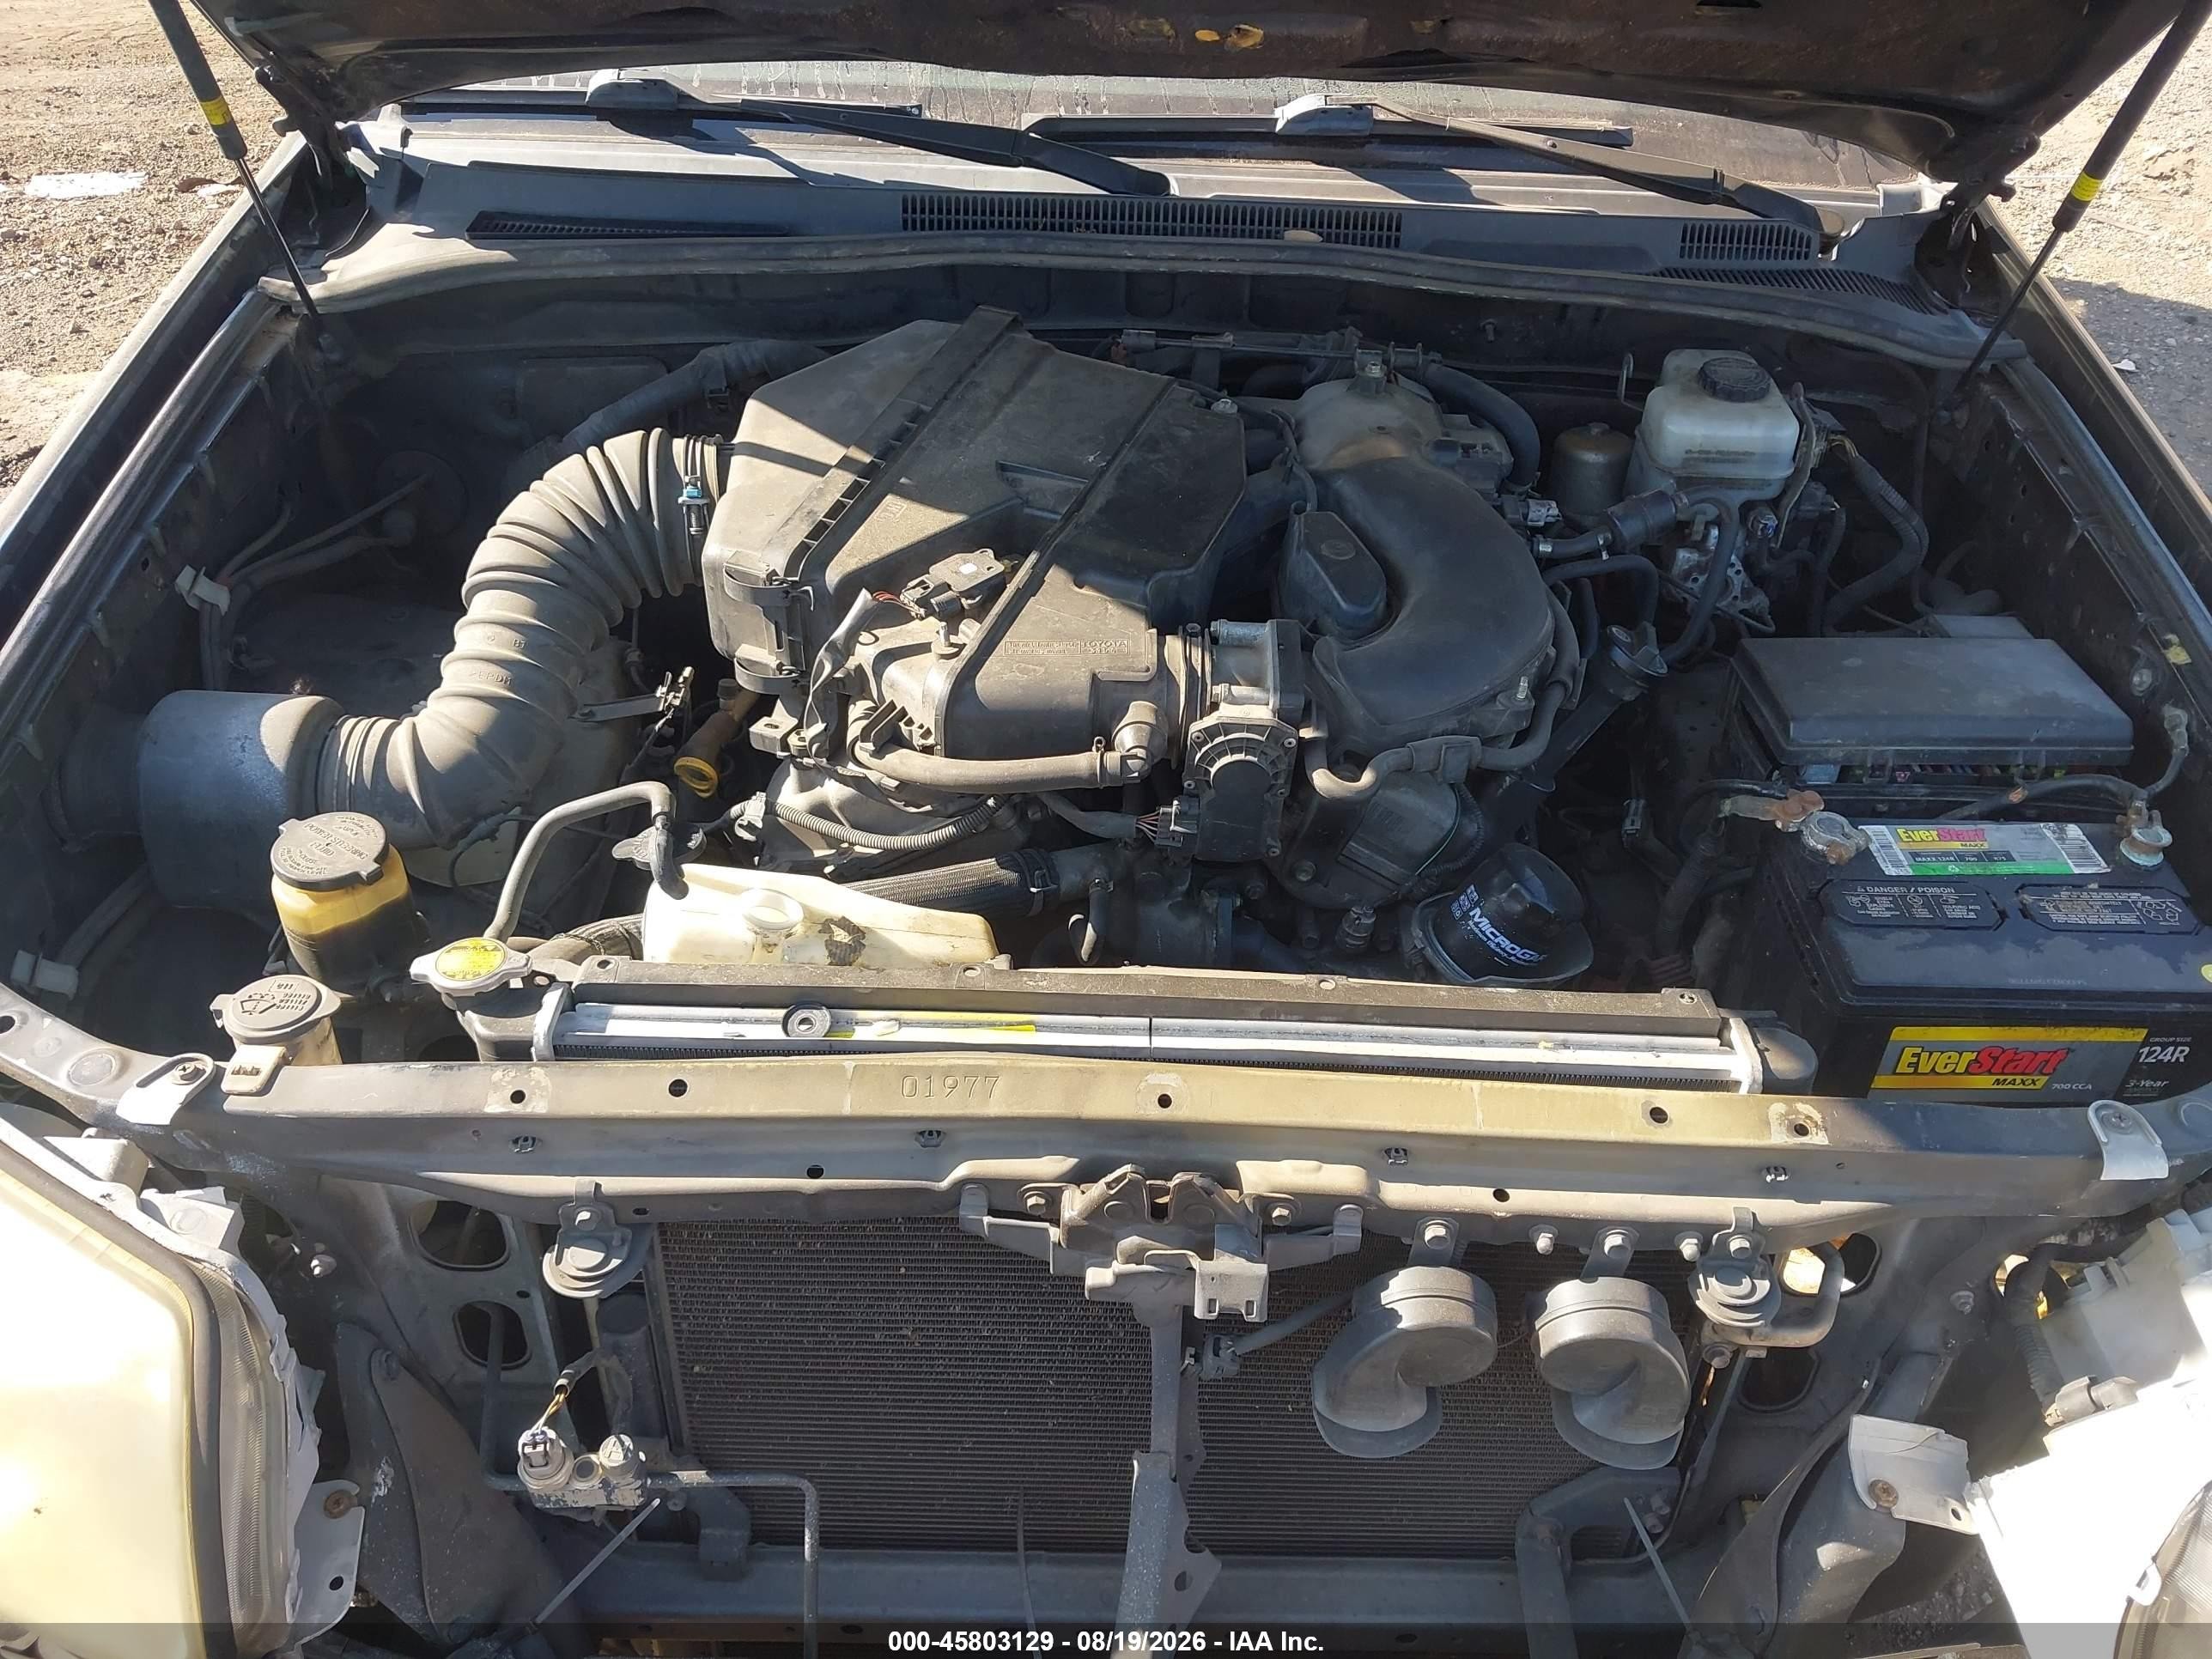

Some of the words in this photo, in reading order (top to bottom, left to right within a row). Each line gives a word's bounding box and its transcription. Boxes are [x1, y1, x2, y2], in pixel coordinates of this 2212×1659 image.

[1896, 828, 1985, 842] EverStart
[1894, 1045, 2070, 1076] EverStart
[2137, 1045, 2191, 1063] 124R
[902, 1074, 1001, 1099] 01977
[1991, 1078, 2041, 1087] MAXX
[2125, 1079, 2170, 1088] 3-Year
